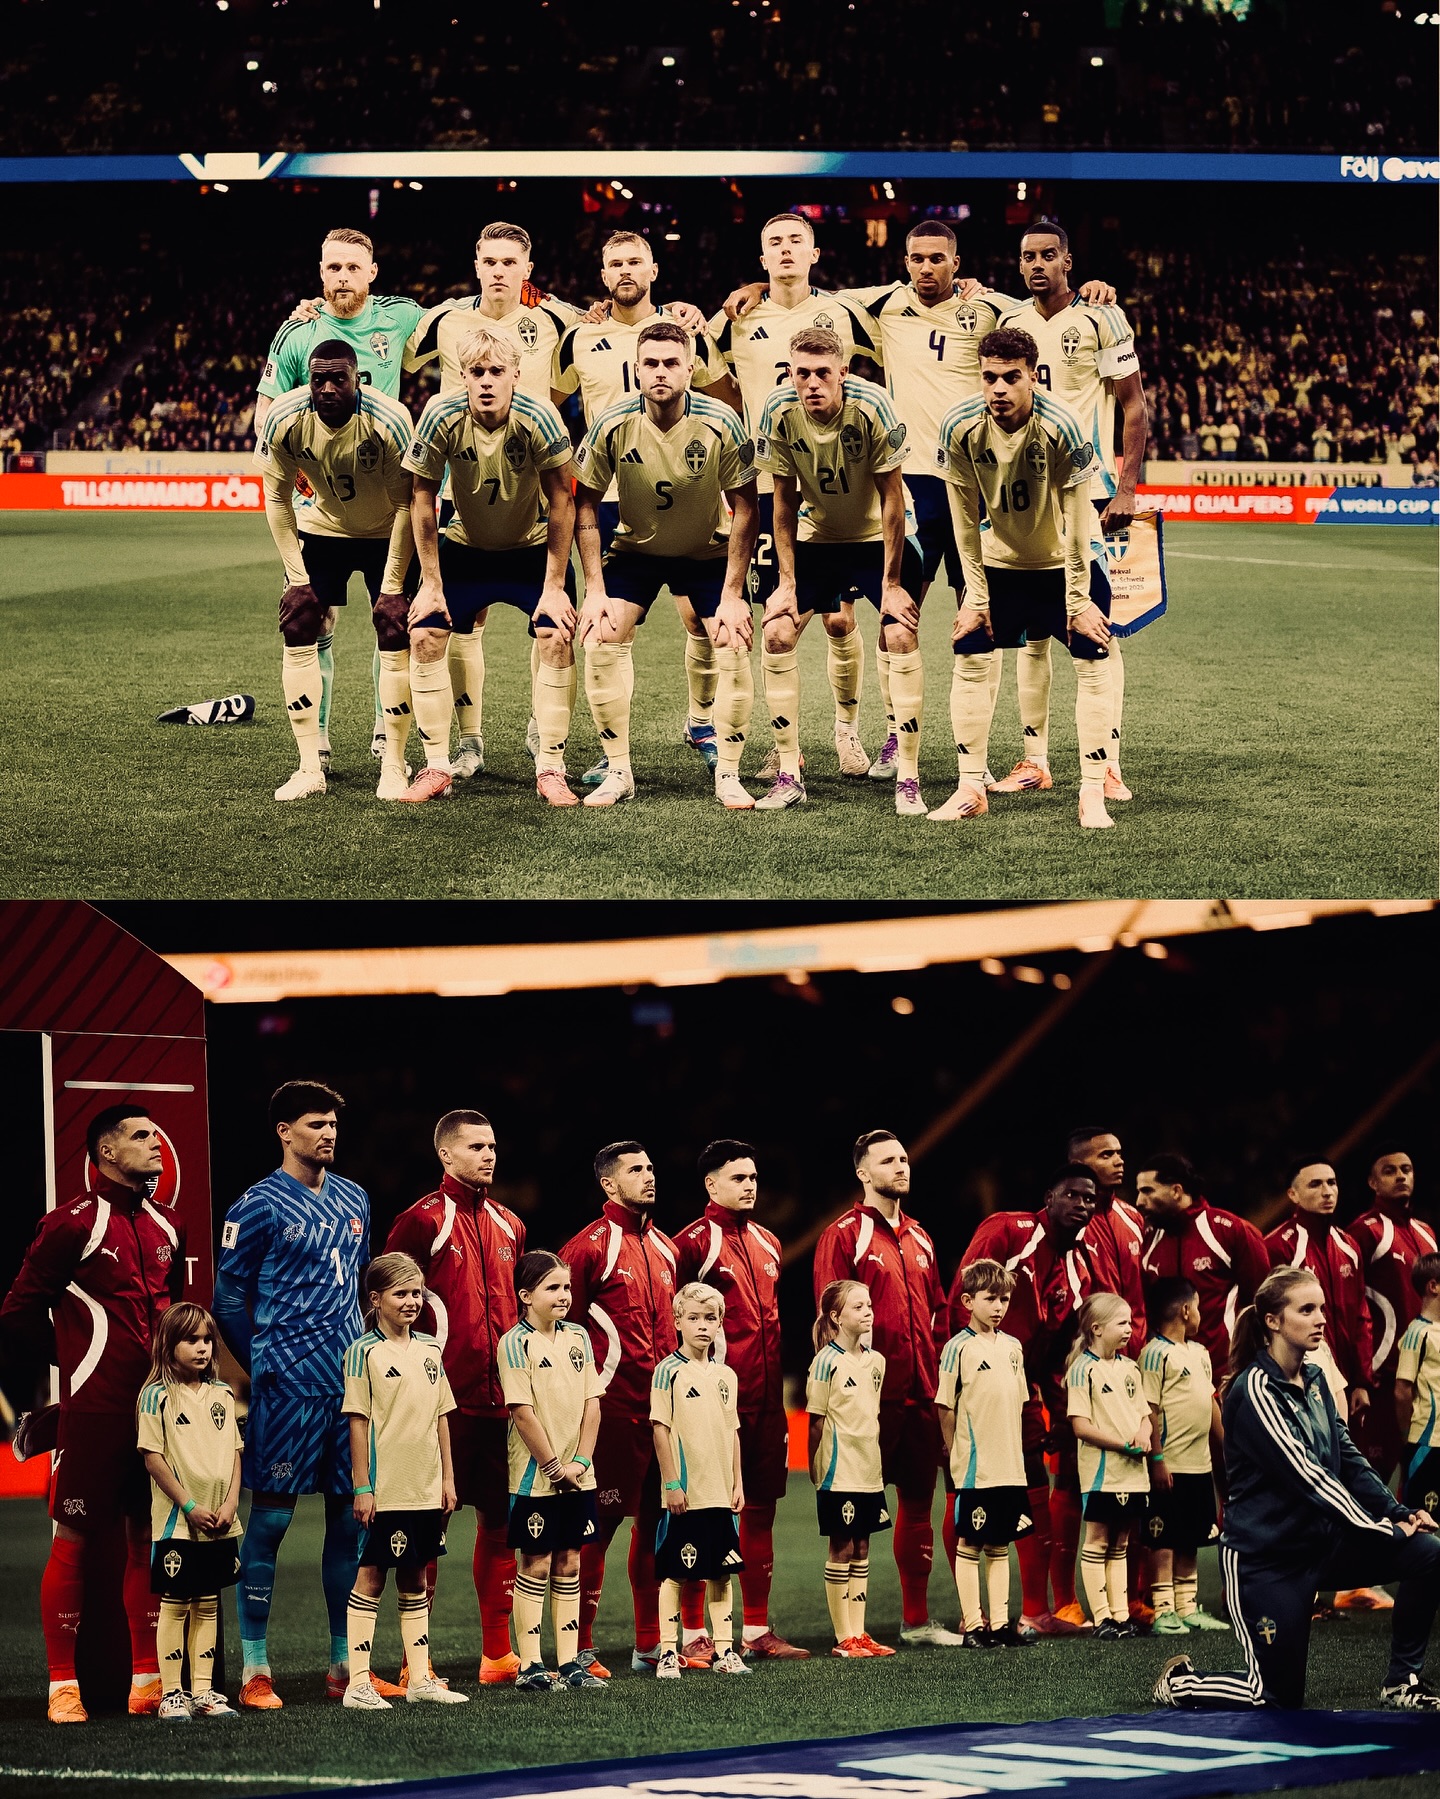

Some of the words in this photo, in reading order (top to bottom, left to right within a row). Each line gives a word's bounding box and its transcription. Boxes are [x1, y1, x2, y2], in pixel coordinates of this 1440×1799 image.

[929, 330, 946, 362] 4
[61, 481, 208, 507] TILLSAMMANS
[211, 476, 260, 508] FÖR
[326, 473, 357, 502] 13
[483, 477, 501, 506] 7
[655, 480, 674, 511] 5
[817, 466, 850, 495] 21
[1000, 479, 1031, 514] 18
[1193, 495, 1295, 515] QUALIFIERS
[1304, 497, 1340, 514] FIFA
[1340, 498, 1397, 515] WORLD
[1398, 499, 1431, 515] CUP
[330, 1248, 345, 1286] 1
